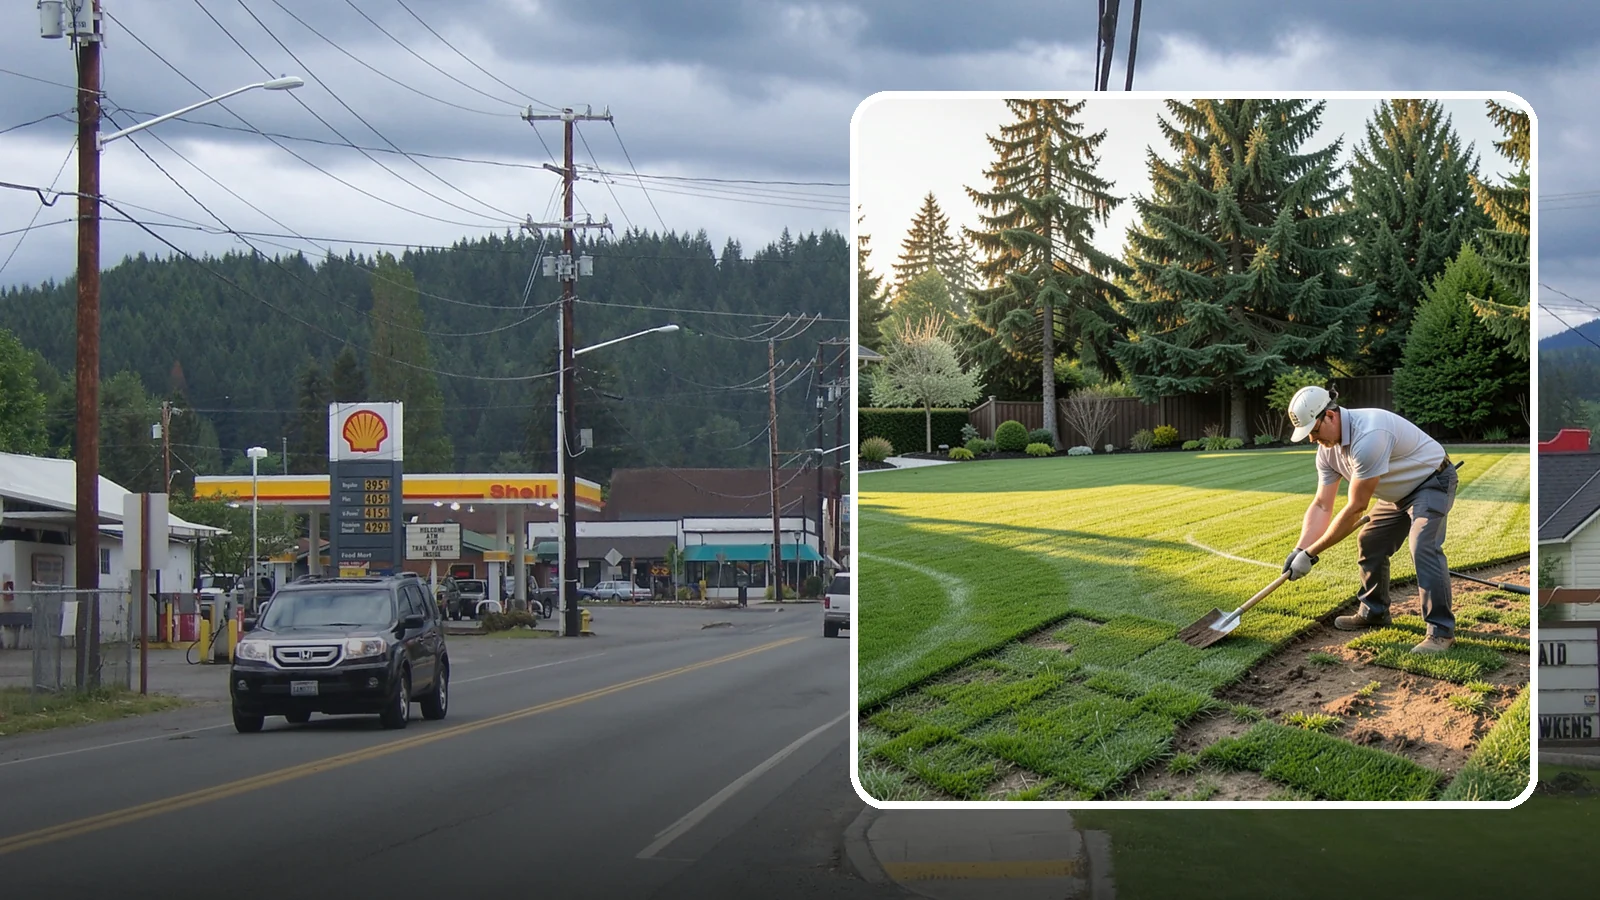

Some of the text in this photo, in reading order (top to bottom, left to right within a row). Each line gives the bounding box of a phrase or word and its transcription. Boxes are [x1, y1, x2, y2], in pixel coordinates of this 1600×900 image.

[366, 480, 383, 490] 395
[490, 484, 547, 499] Shell
[366, 494, 383, 504] 405
[366, 508, 383, 518] 415
[366, 522, 383, 532] 429
